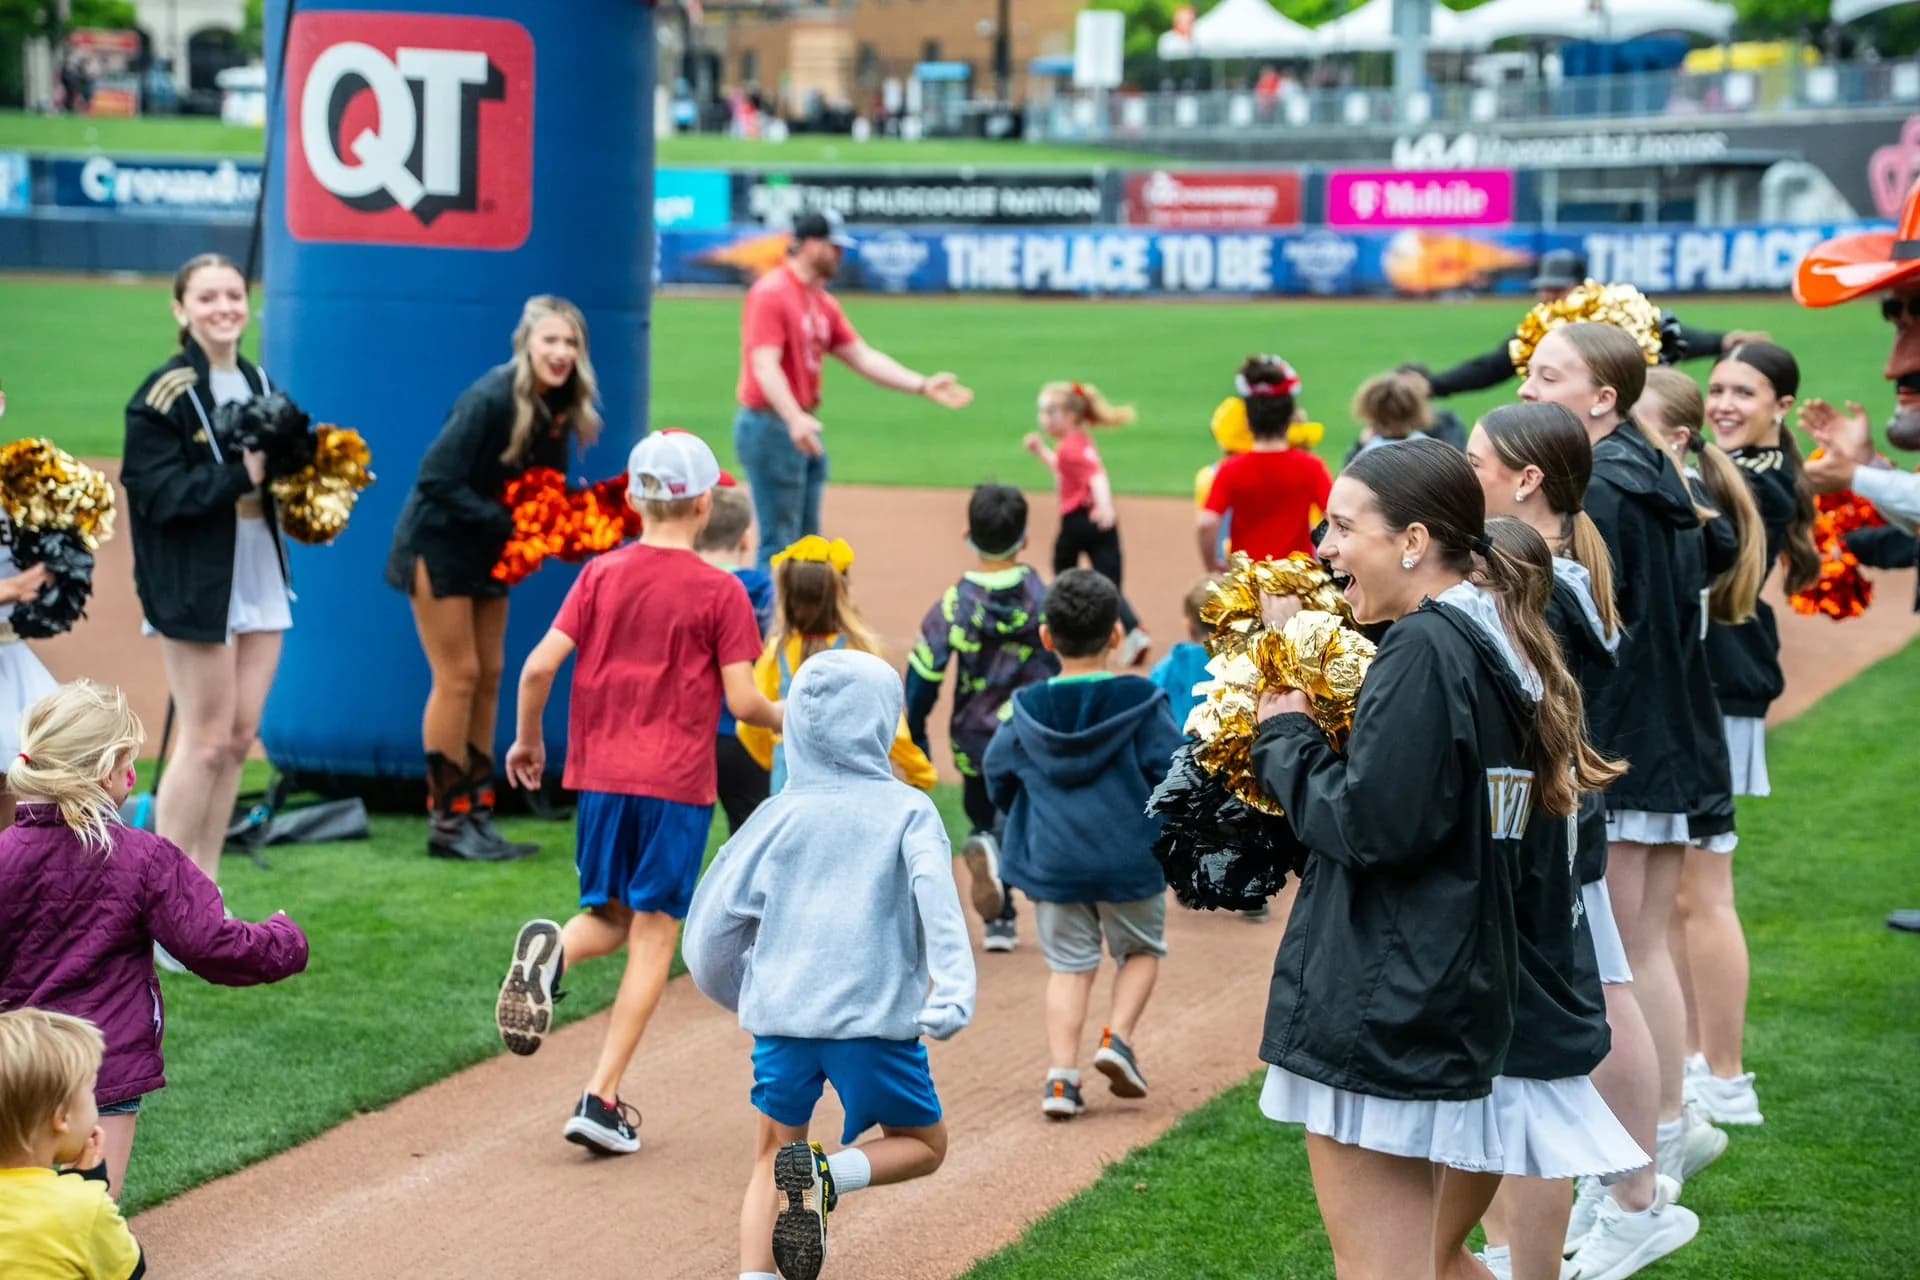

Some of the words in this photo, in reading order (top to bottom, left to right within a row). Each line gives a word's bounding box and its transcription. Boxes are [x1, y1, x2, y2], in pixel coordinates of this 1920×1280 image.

[302, 41, 489, 211] QT
[1000, 185, 1101, 216] NATION
[943, 233, 1020, 289] THE
[1022, 233, 1149, 290] PLACE
[1156, 233, 1215, 289] TO
[1217, 233, 1273, 289] BE
[1583, 232, 1672, 291] THE
